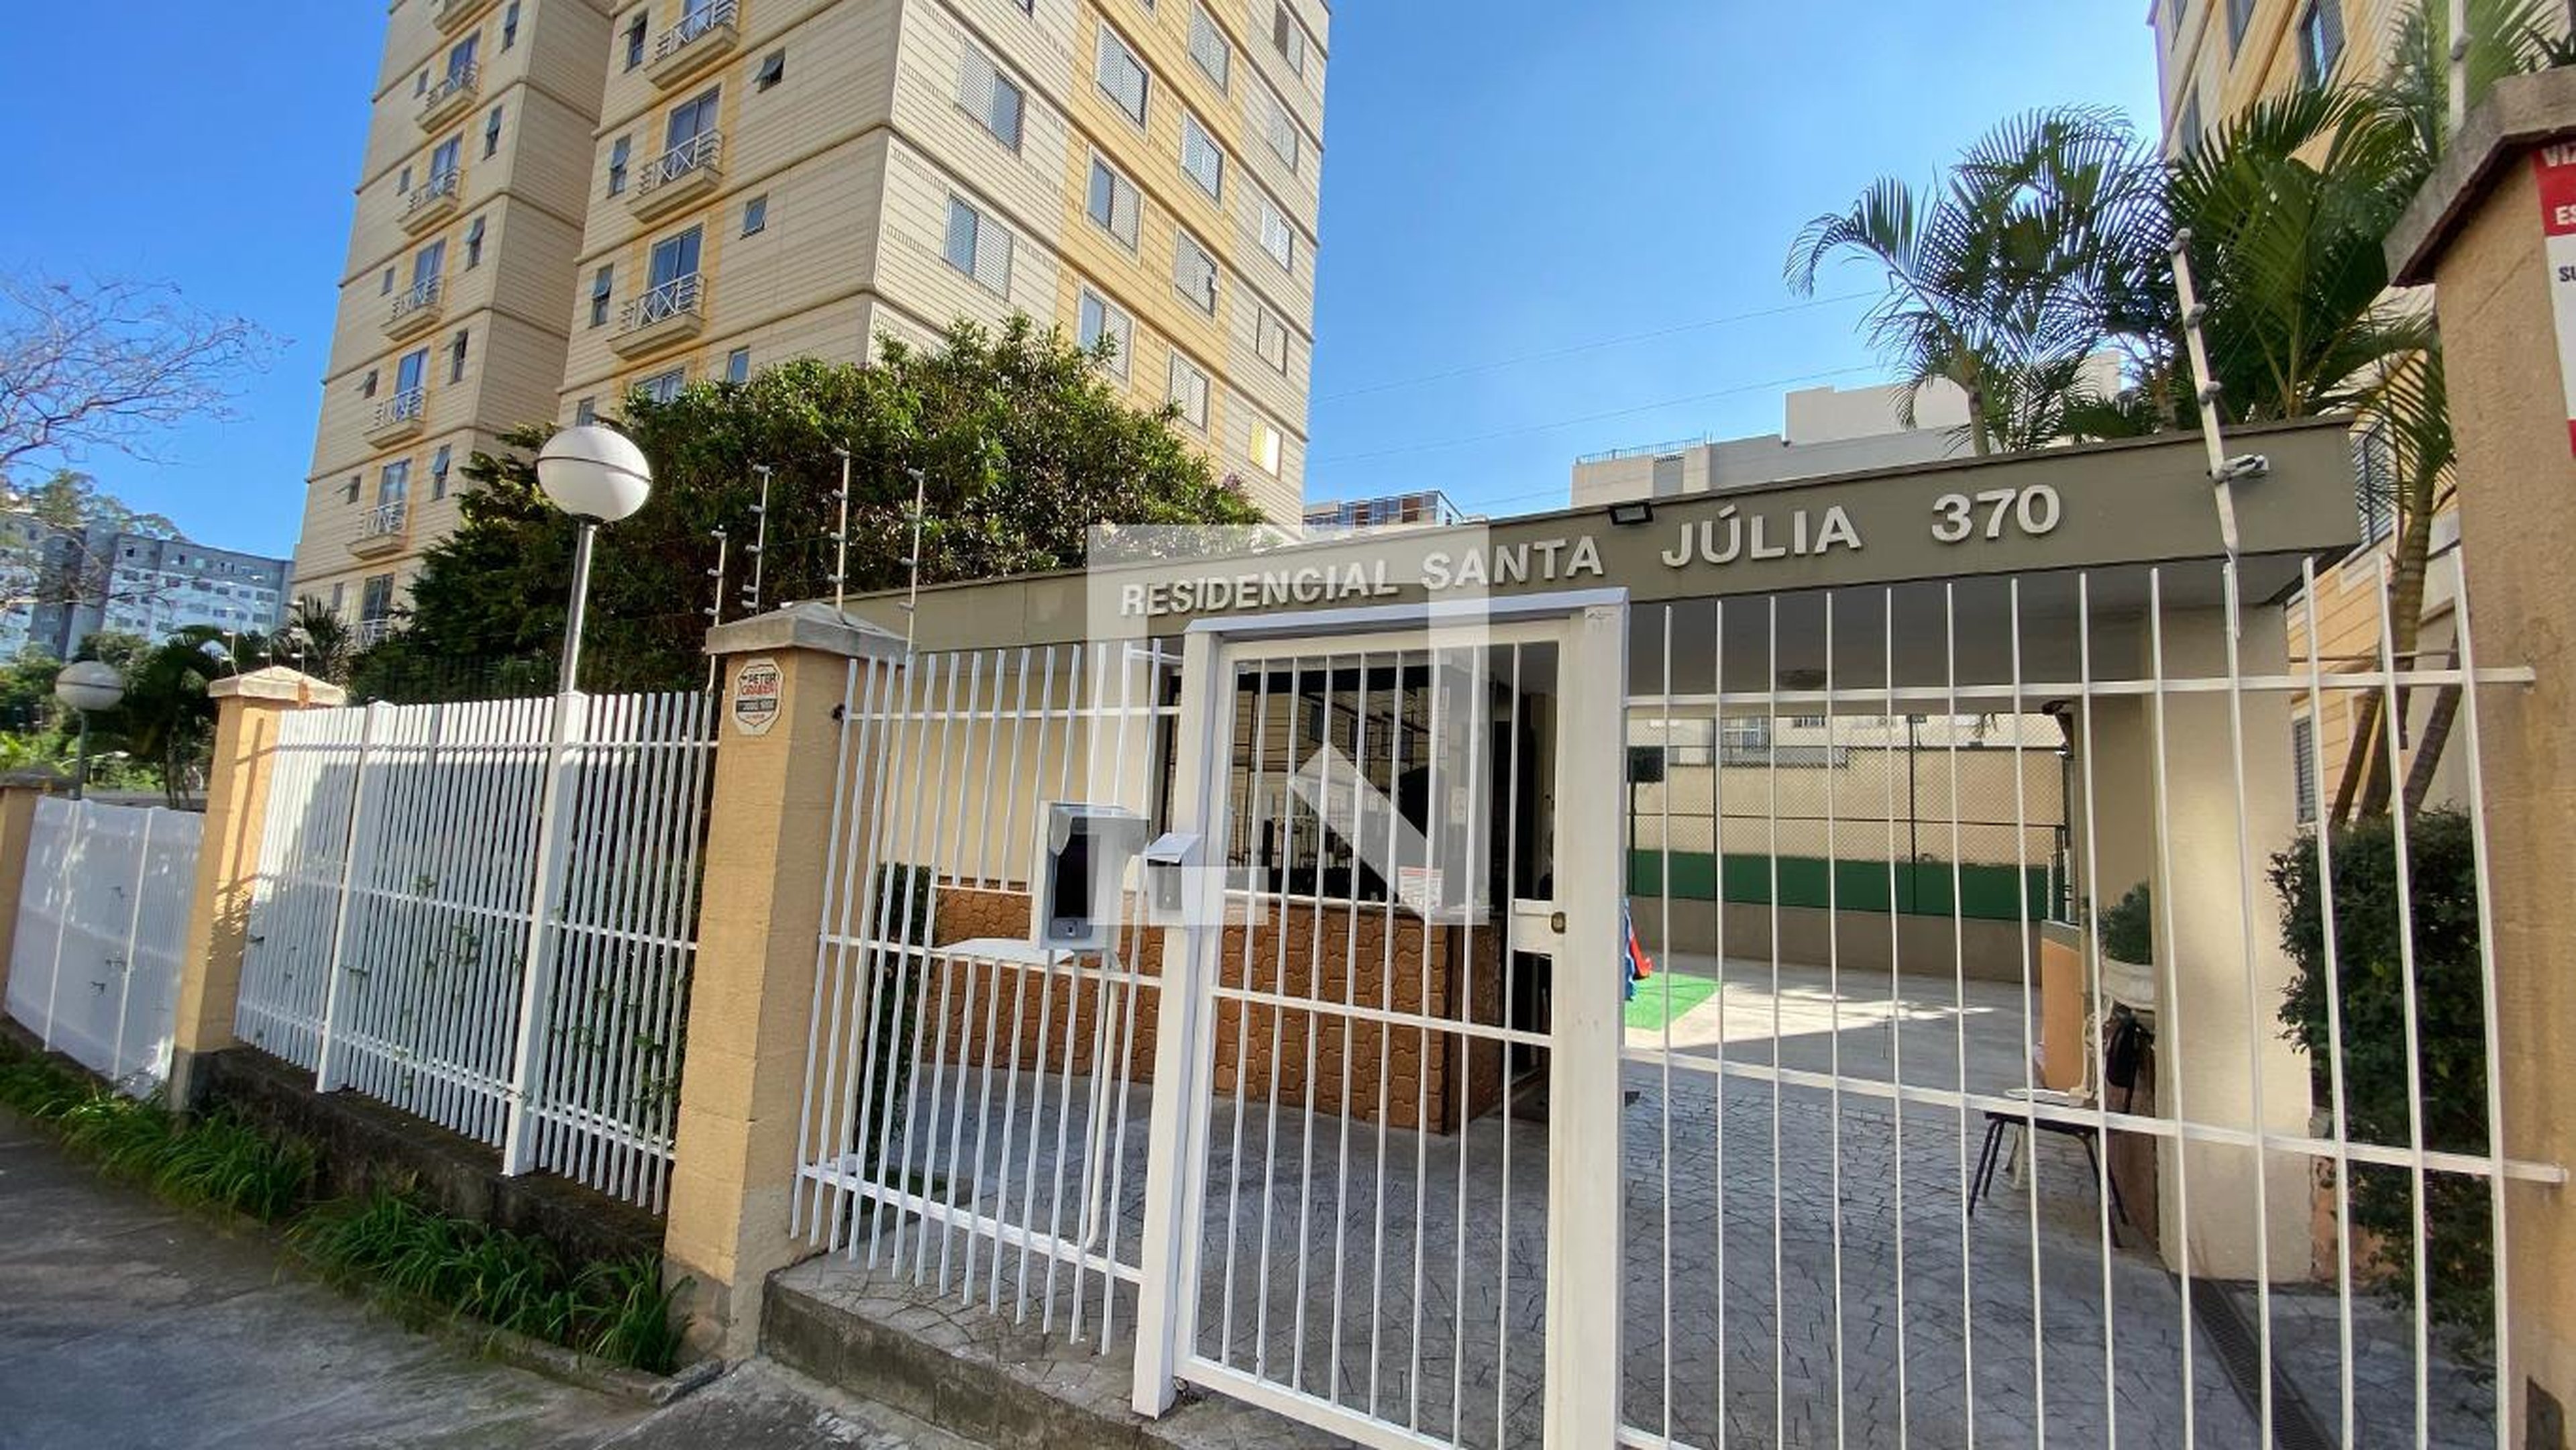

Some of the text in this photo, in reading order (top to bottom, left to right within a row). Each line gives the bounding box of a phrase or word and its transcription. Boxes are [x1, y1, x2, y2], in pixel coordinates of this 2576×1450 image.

[1120, 484, 2061, 616] RESIDENCIAL SANTA JÚLIA 370
